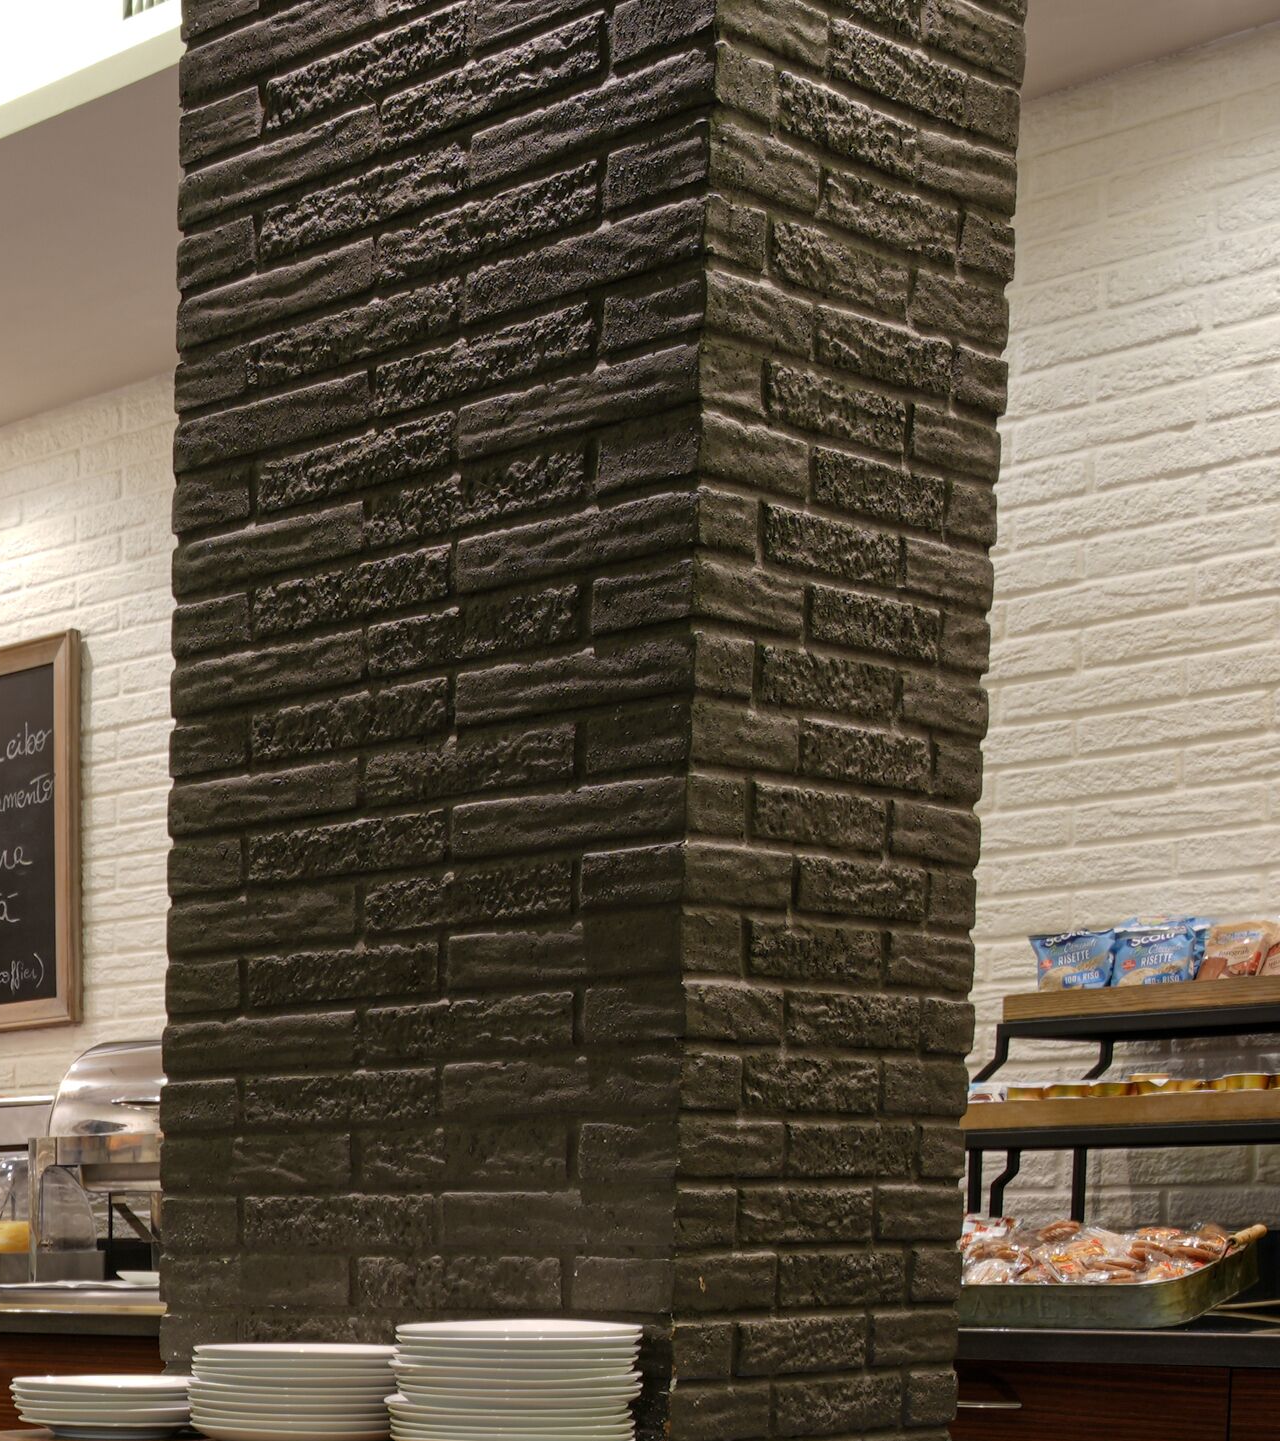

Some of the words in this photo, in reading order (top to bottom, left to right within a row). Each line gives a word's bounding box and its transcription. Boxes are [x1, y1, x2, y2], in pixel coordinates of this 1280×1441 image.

[6, 720, 53, 760] cibo
[1058, 949, 1090, 966] RISETTE
[1140, 952, 1174, 967] RISETTE
